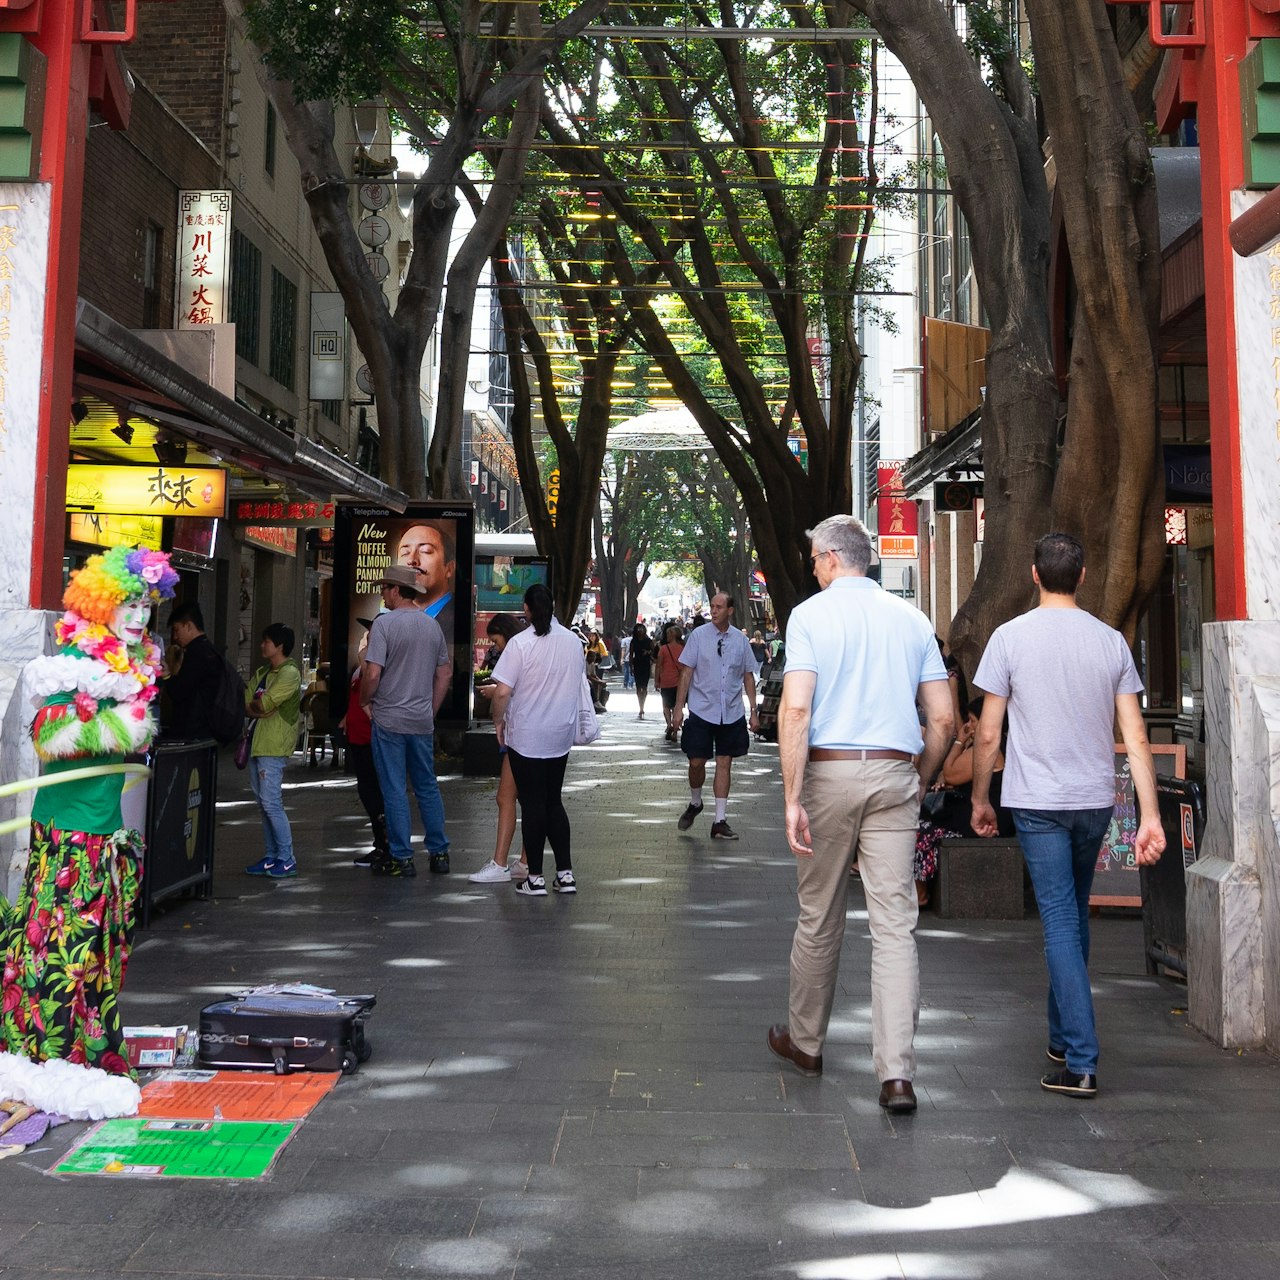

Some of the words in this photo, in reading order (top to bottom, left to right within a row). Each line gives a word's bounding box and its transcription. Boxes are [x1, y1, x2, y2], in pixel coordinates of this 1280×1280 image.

[878, 461, 906, 470] DIXO
[353, 508, 390, 517] Telephone
[358, 523, 387, 540] New
[357, 543, 386, 555] TOFFEE
[357, 555, 391, 568] ALMOND
[356, 569, 384, 580] PANNA
